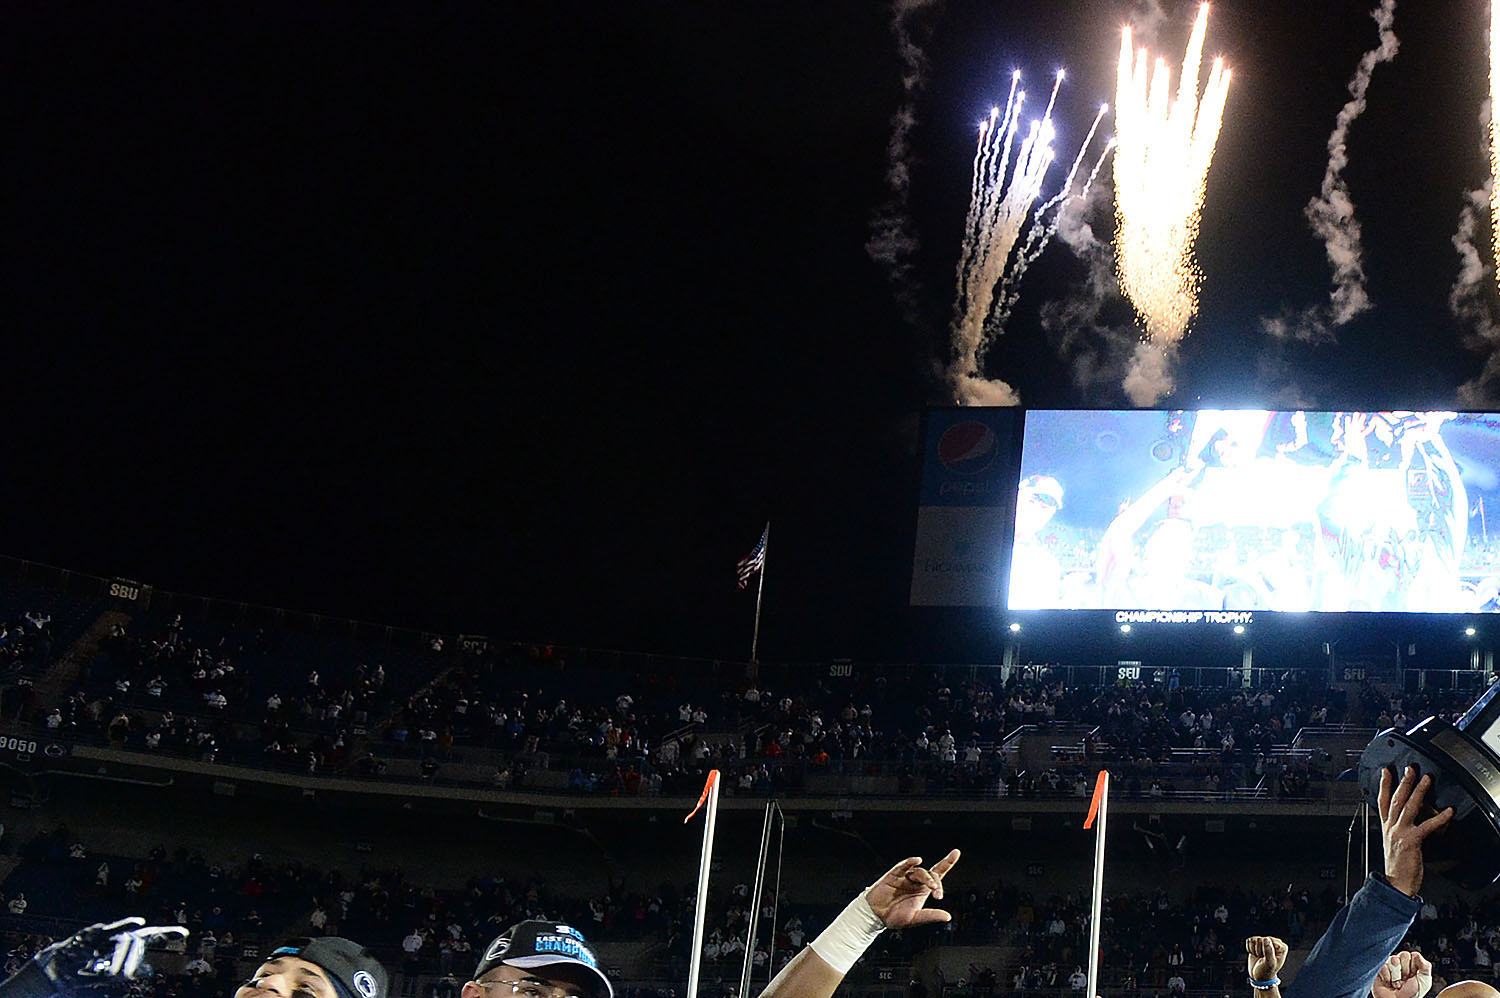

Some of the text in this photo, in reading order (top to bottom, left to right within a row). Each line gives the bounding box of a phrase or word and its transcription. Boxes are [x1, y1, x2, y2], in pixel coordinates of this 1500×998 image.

[109, 583, 140, 600] SBU
[1115, 610, 1254, 624] CHAMPIONSHIP TROPHY.
[1117, 666, 1141, 680] SEU
